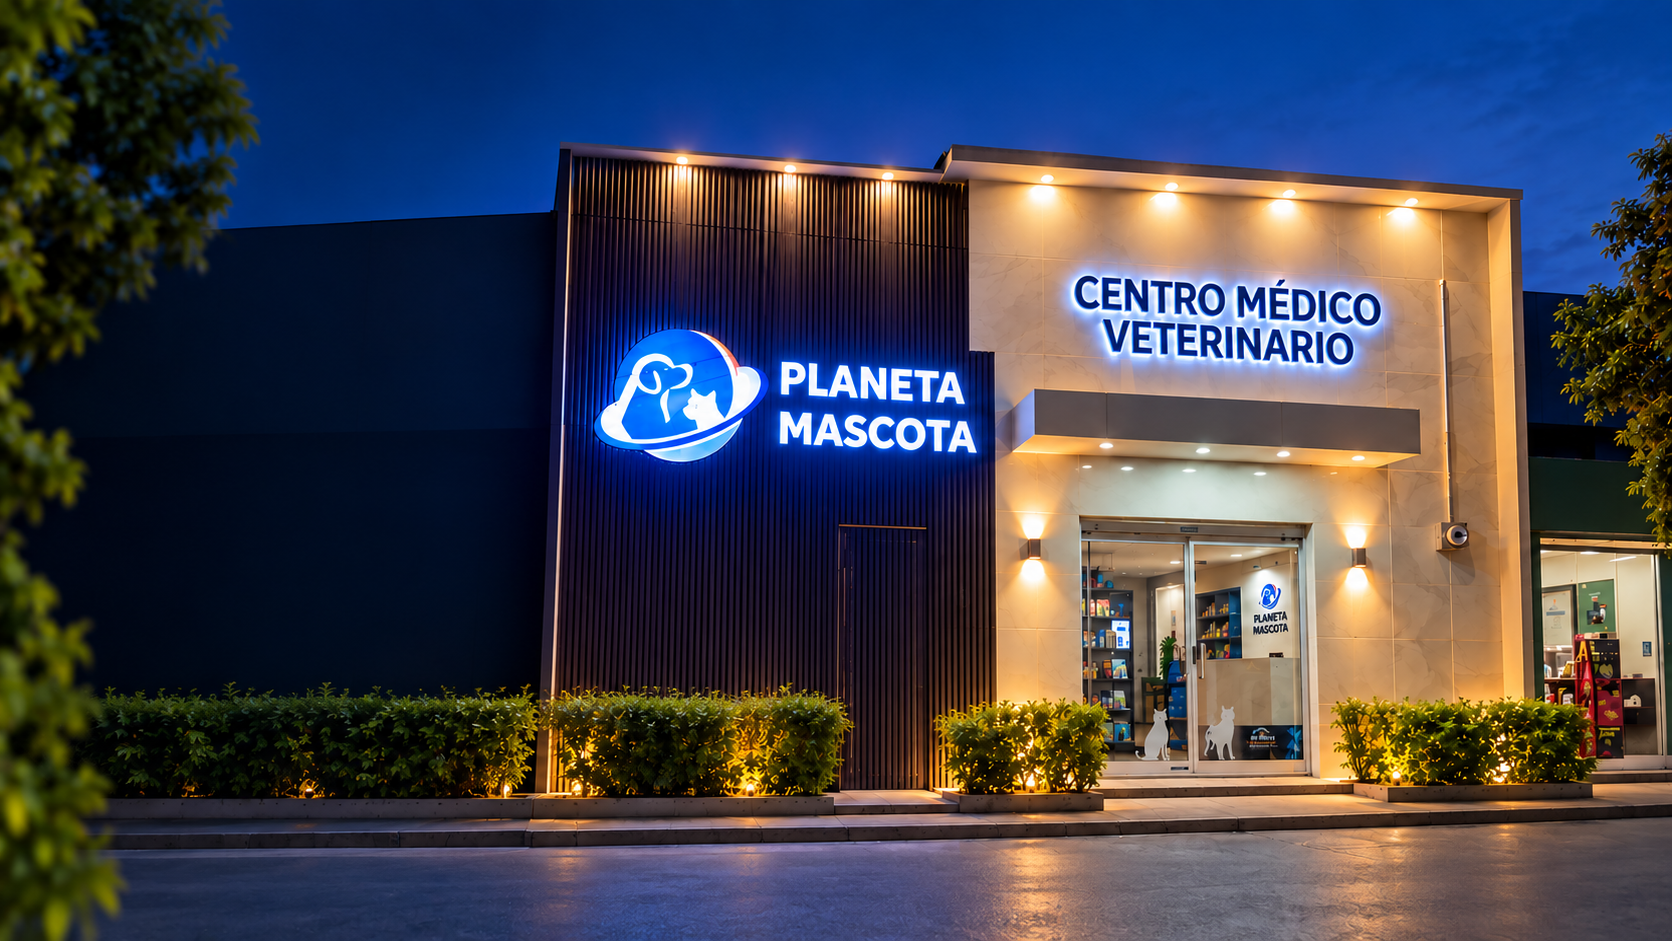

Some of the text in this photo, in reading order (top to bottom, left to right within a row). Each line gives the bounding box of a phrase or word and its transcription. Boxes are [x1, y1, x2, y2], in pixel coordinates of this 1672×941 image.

[1074, 275, 1382, 326] CENTRO MÉDICO
[1102, 318, 1354, 365] VETERINARIO
[780, 361, 966, 405] PLANETA
[779, 411, 978, 454] MASCOTA
[1253, 611, 1288, 623] PLANETA
[1253, 623, 1289, 635] MASCOTA
